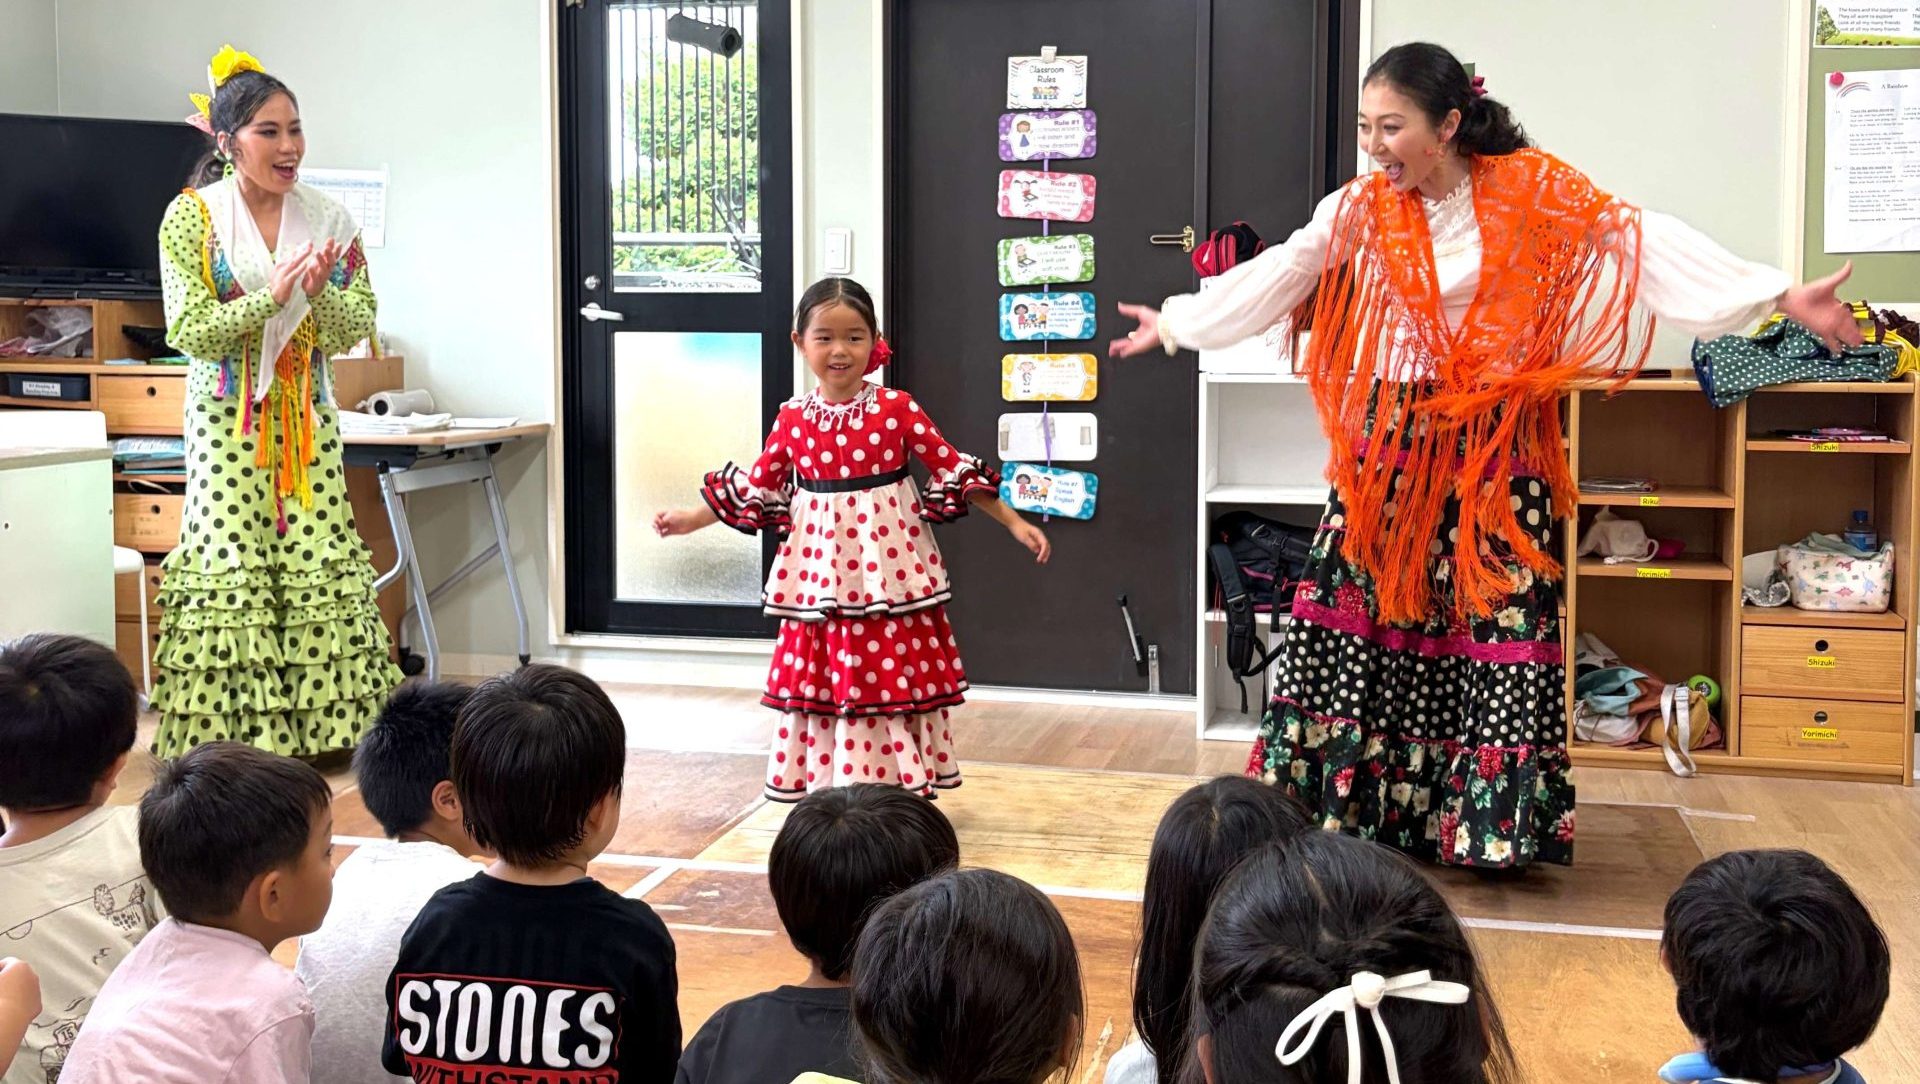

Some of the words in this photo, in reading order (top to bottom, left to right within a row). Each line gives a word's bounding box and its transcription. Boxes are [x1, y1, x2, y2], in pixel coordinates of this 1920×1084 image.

[1029, 65, 1065, 74] Classroom
[1037, 75, 1057, 83] Rules
[1811, 443, 1838, 451] Shizuki
[1637, 570, 1671, 578] Yorimichi
[1808, 658, 1835, 667] Shizuki
[1802, 730, 1837, 739] Yorimichi
[398, 979, 616, 1068] STONES
